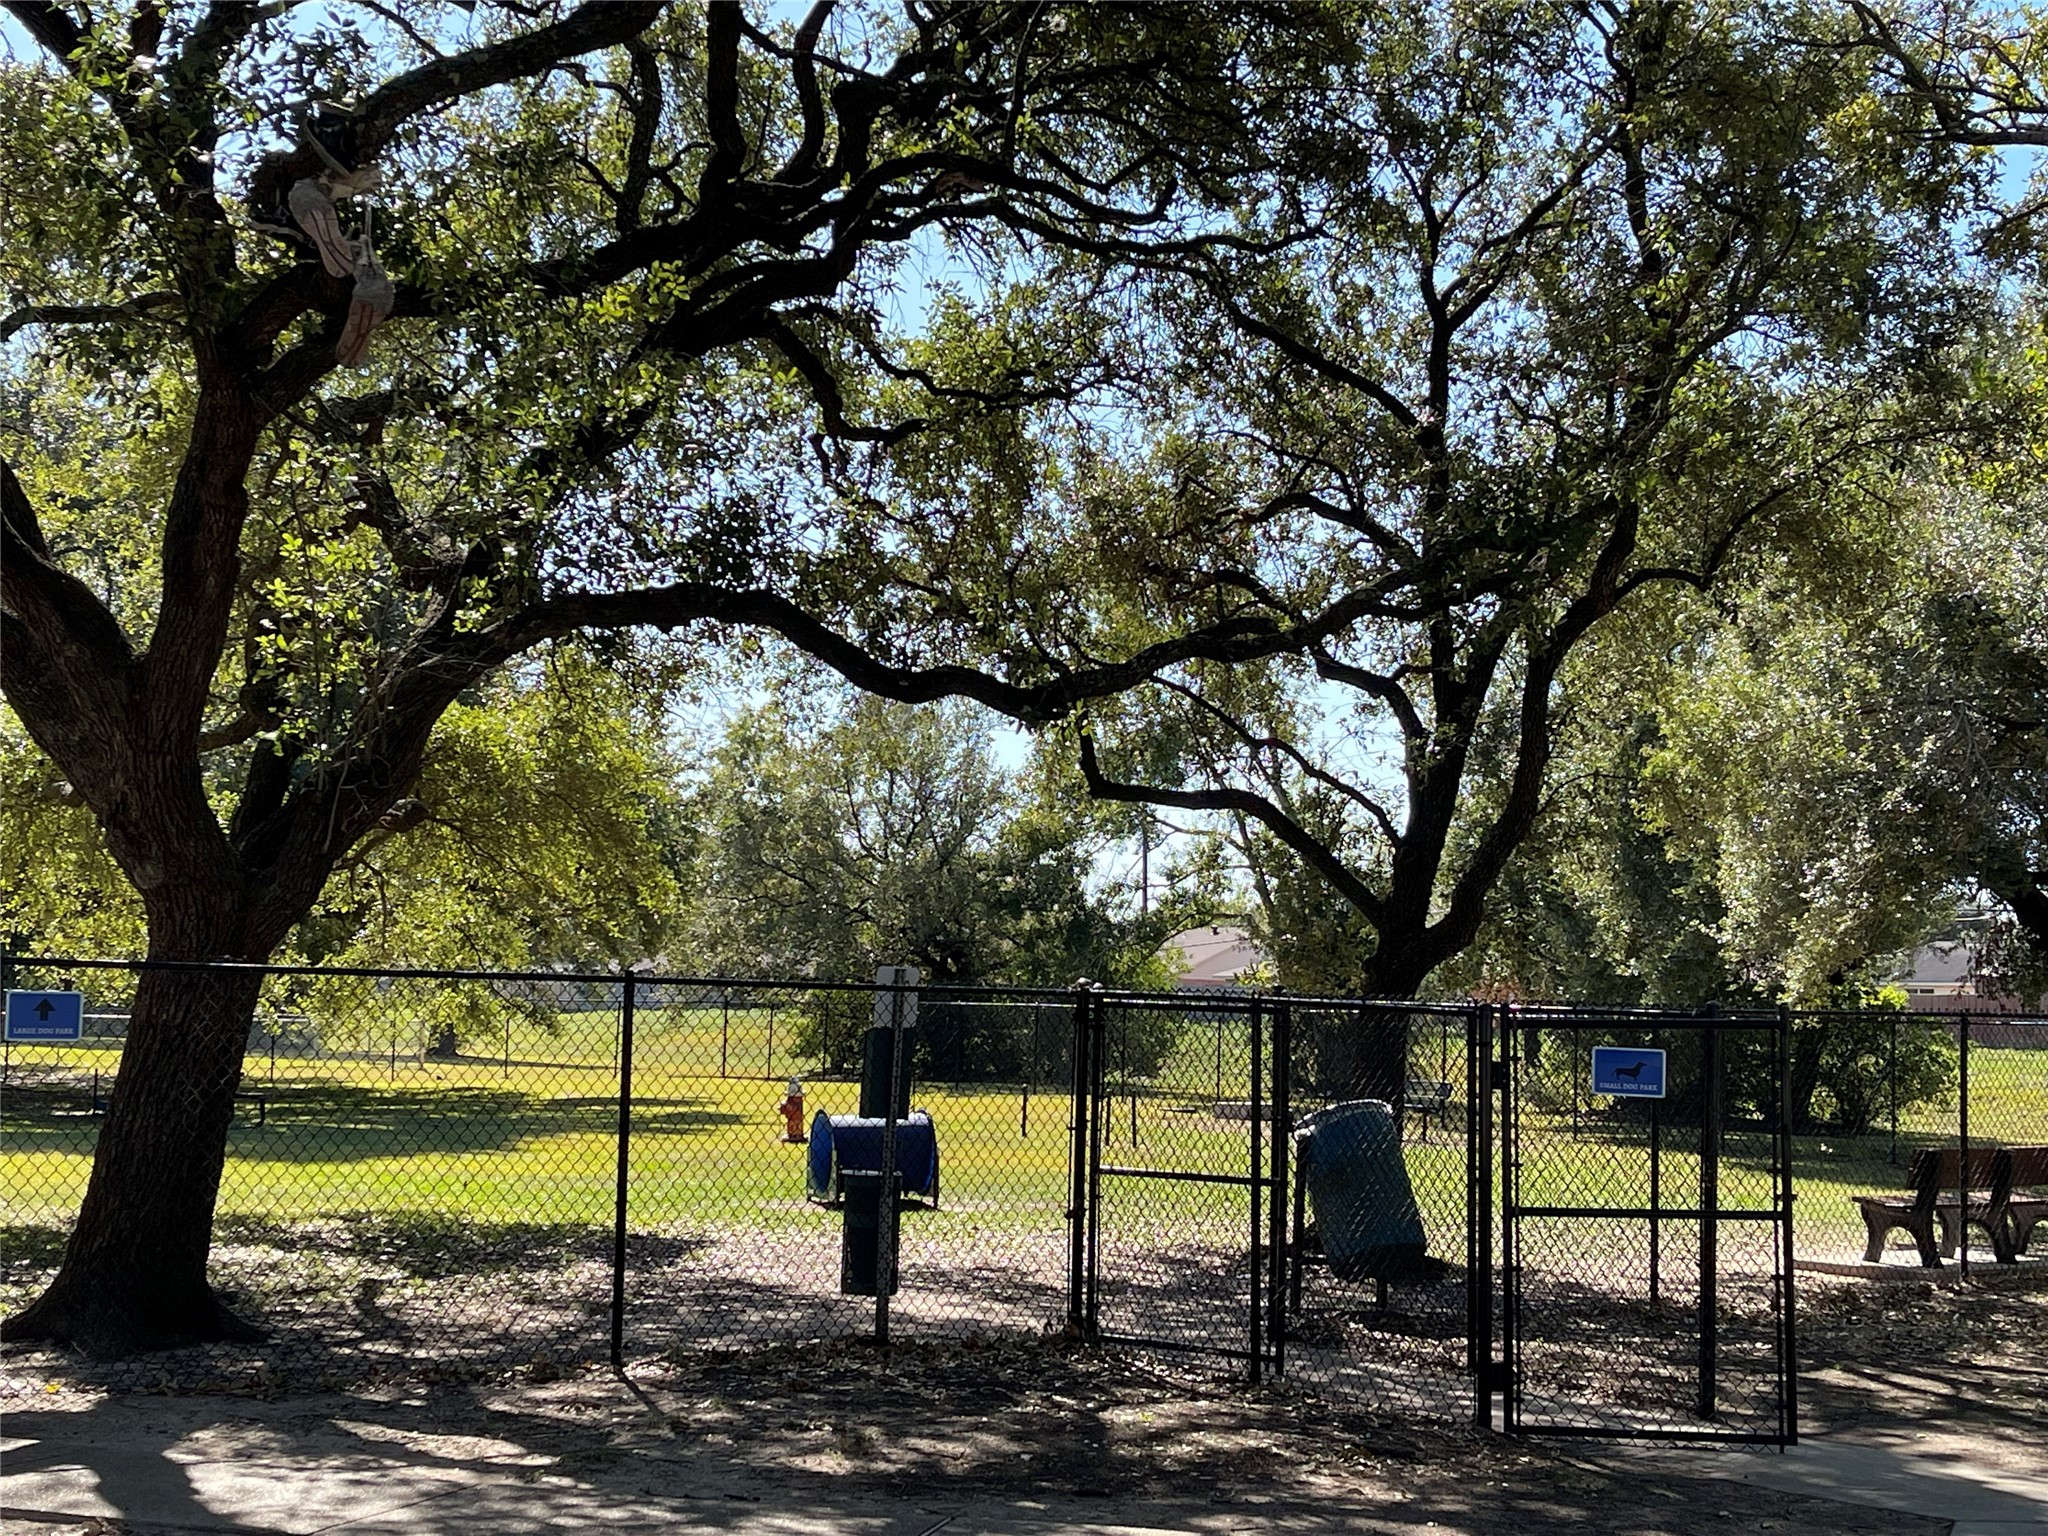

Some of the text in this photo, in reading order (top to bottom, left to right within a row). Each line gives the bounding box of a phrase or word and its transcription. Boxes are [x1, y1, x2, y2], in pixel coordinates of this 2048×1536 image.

[13, 1027, 74, 1035] LARGE DOG PARK
[1599, 1082, 1658, 1092] SMALL DOG PARK
